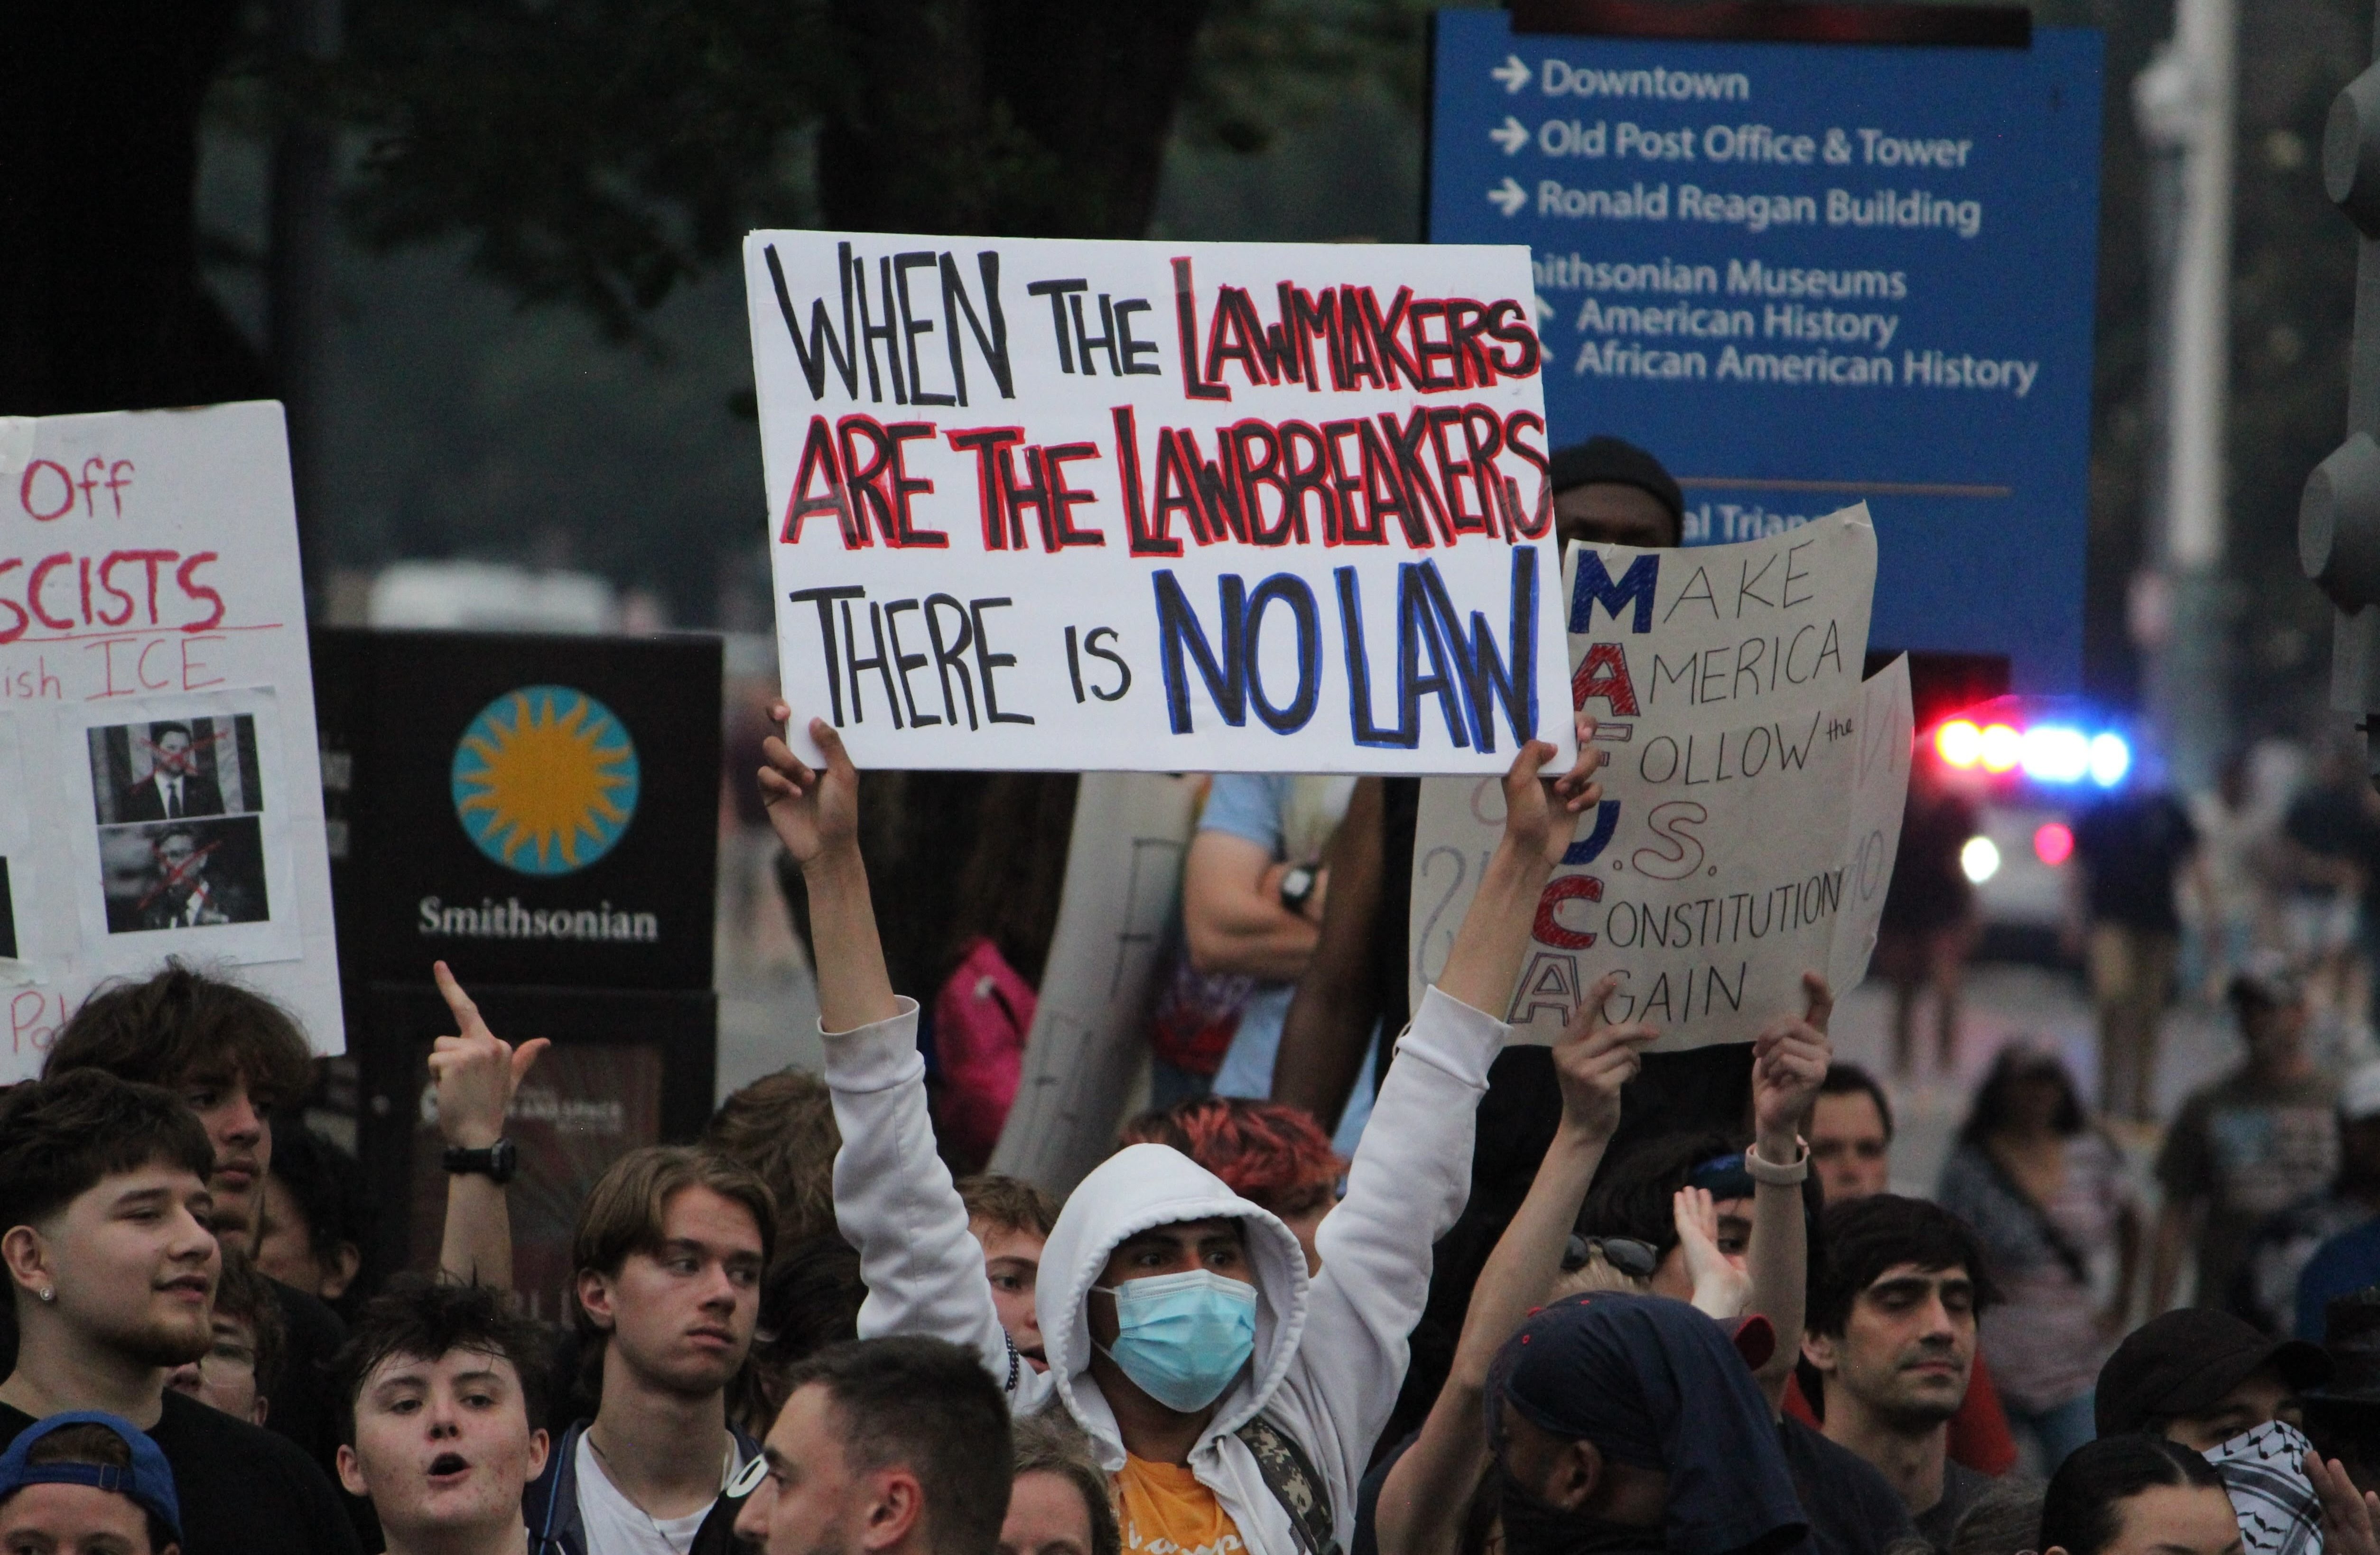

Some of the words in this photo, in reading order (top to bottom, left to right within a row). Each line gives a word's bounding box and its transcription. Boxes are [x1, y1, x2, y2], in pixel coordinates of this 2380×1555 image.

[1542, 58, 1750, 100] Downtown
[1538, 119, 1607, 157] Old
[1616, 122, 1695, 160] Post
[1703, 124, 1815, 165] Office
[1823, 127, 1851, 165] &
[1857, 128, 1973, 167] Tower
[1537, 179, 1669, 219] Ronald
[1678, 184, 1816, 233] Reagan
[1827, 189, 1981, 237] Building
[1726, 258, 1907, 299] Museums
[764, 241, 1015, 407] WHEN
[1027, 278, 1161, 376] THE
[1170, 256, 1541, 401] LAWMAKERS
[1576, 297, 1755, 338] American
[1763, 303, 1898, 351] History
[1574, 339, 1707, 378] African
[1716, 345, 1894, 386] American
[1904, 349, 2039, 398] History
[21, 455, 136, 521] Off
[780, 414, 949, 550] ARE
[941, 426, 1106, 554] THE
[1110, 403, 1553, 558] LAWBREAKERS
[1569, 539, 1814, 634] MAKE
[84, 636, 226, 701] ICE
[789, 585, 1035, 731] THERE
[1065, 626, 1131, 703] IS
[1152, 569, 1323, 735] NO
[1333, 545, 1539, 754] LAW
[1572, 619, 1841, 717] AMERICA
[1827, 718, 1854, 741] the
[418, 896, 659, 941] Smithsonian
[1532, 868, 1845, 950] CONSTITUTION
[1507, 952, 1747, 1027] AGAIN
